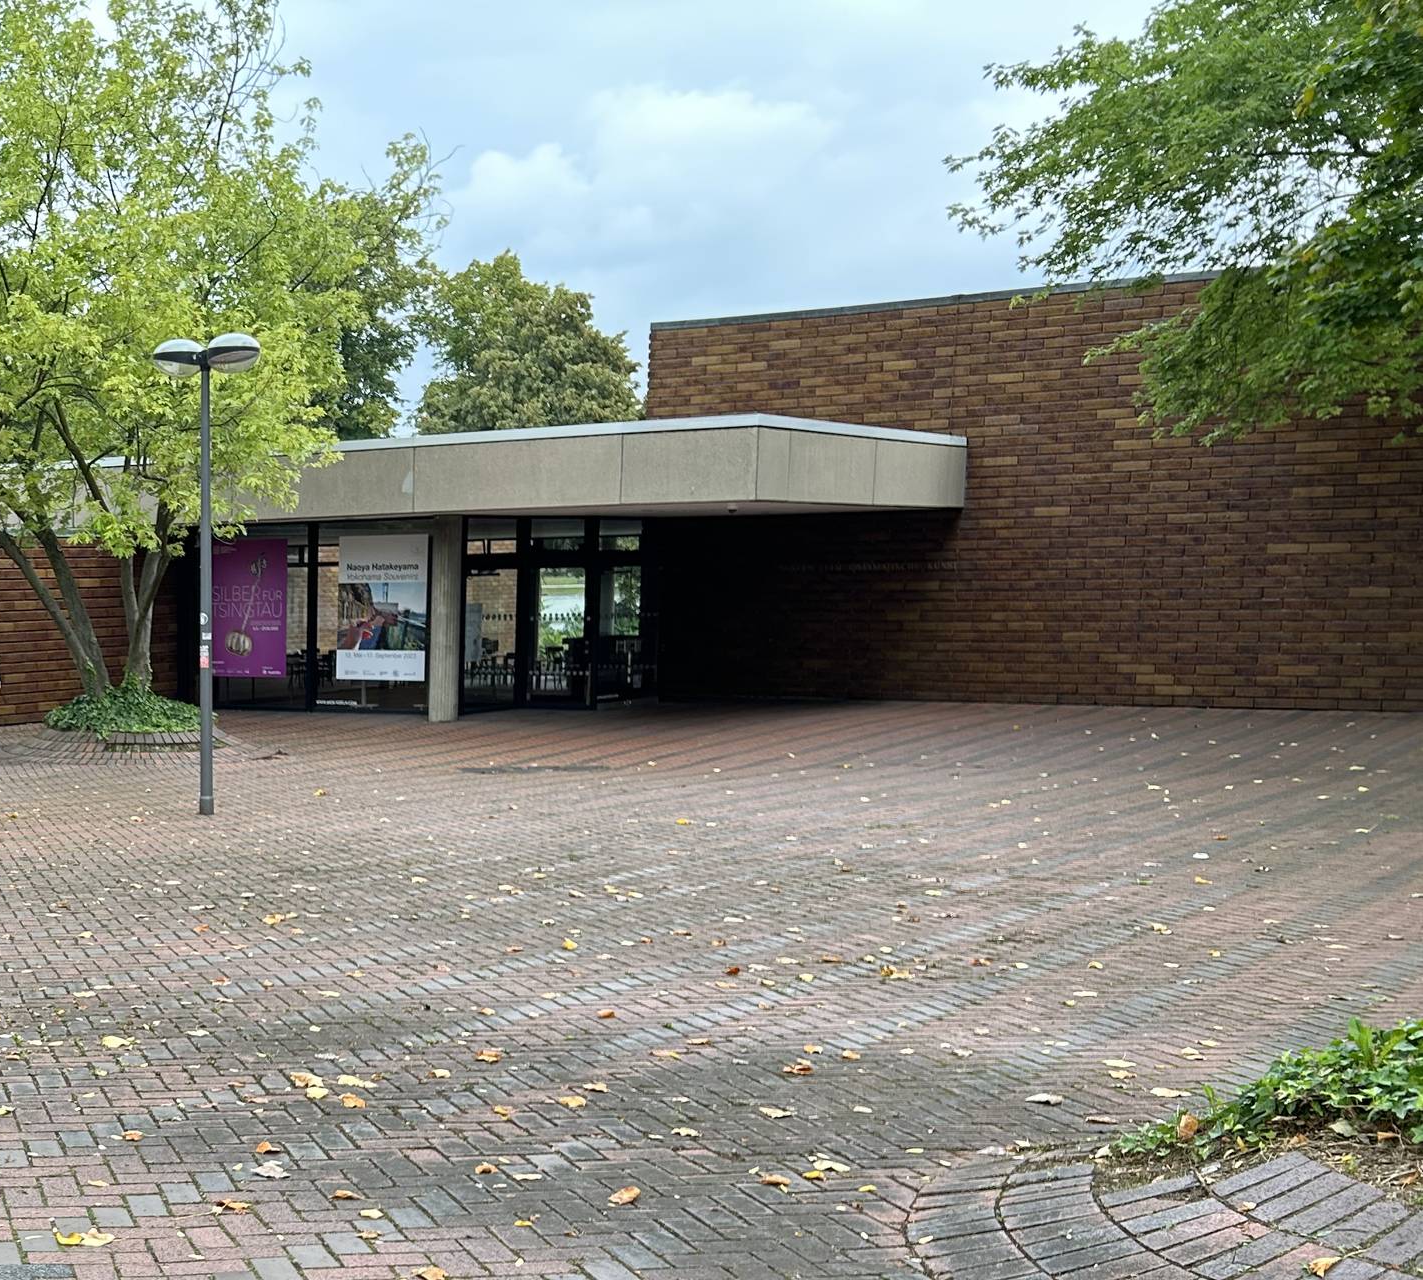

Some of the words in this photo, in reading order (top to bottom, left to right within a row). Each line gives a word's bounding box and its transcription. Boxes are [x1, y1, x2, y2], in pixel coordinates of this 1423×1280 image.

[346, 563, 370, 572] Naoya
[212, 585, 261, 602] SILBER
[212, 602, 283, 618] TSINGTAU
